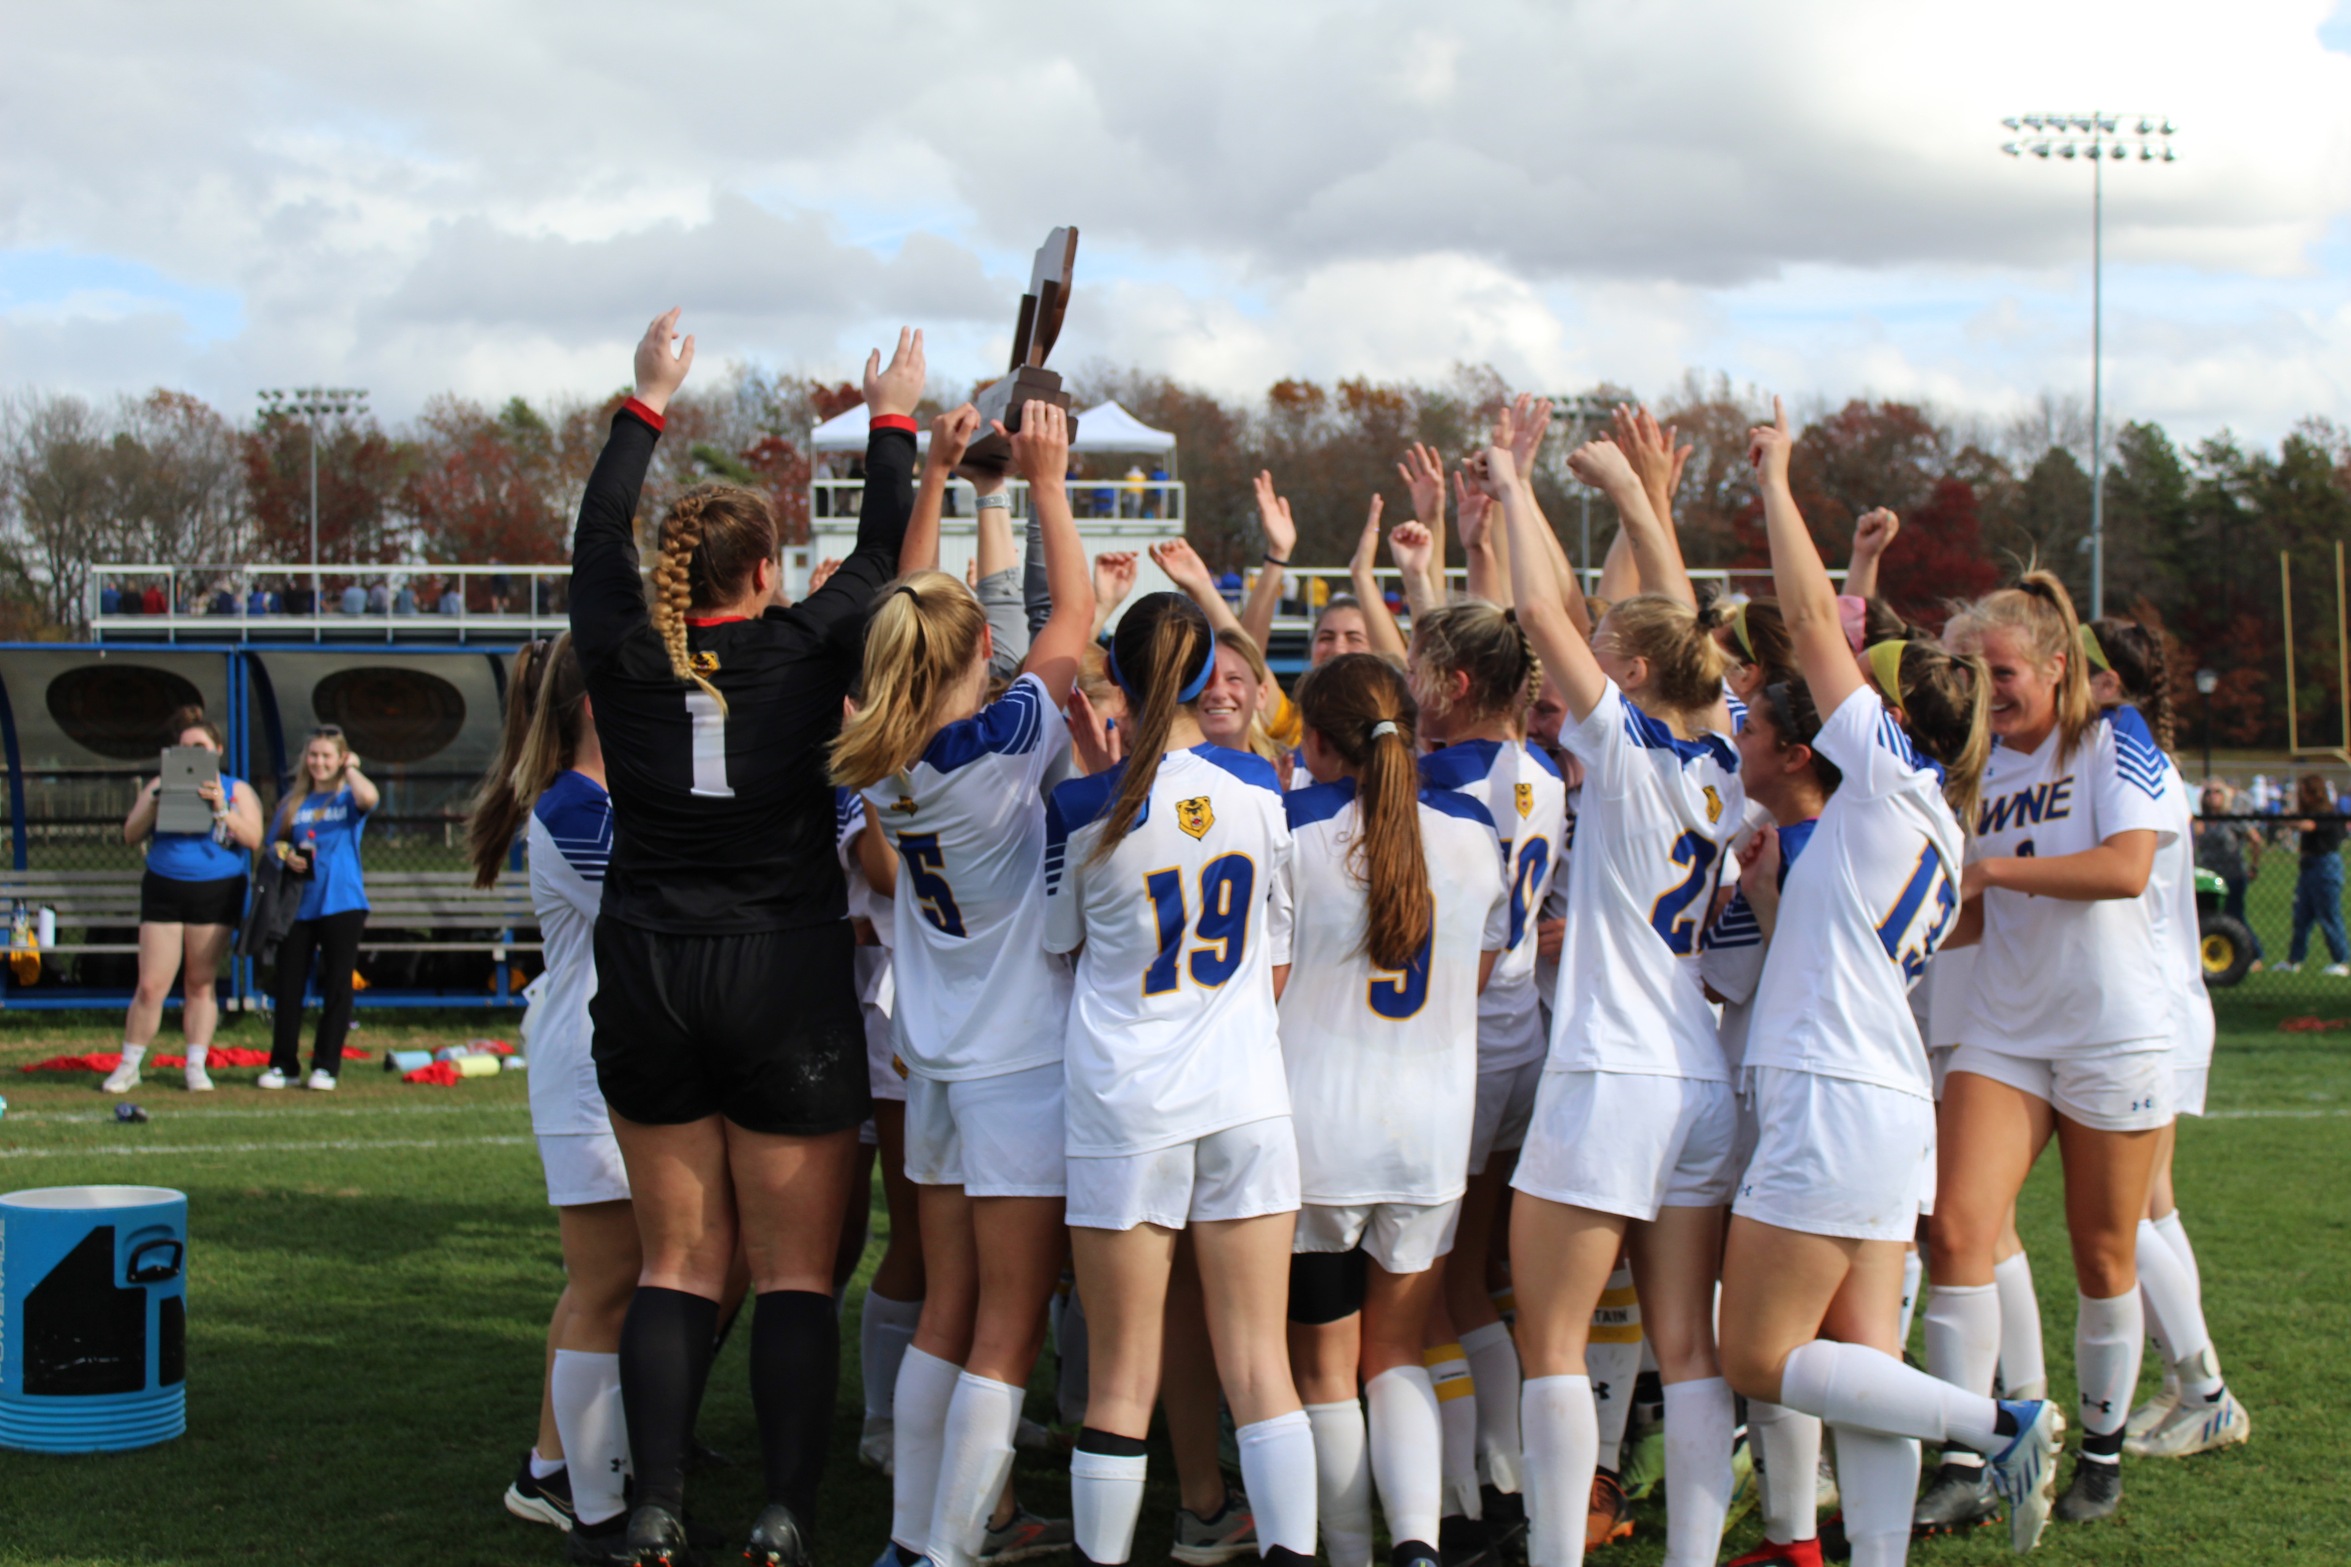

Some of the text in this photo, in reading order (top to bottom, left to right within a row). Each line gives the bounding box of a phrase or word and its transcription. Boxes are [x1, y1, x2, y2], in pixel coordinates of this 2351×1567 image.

[685, 690, 735, 798] 1
[1977, 774, 2075, 836] WNE
[896, 830, 968, 940] 5
[1141, 850, 1256, 998] 19
